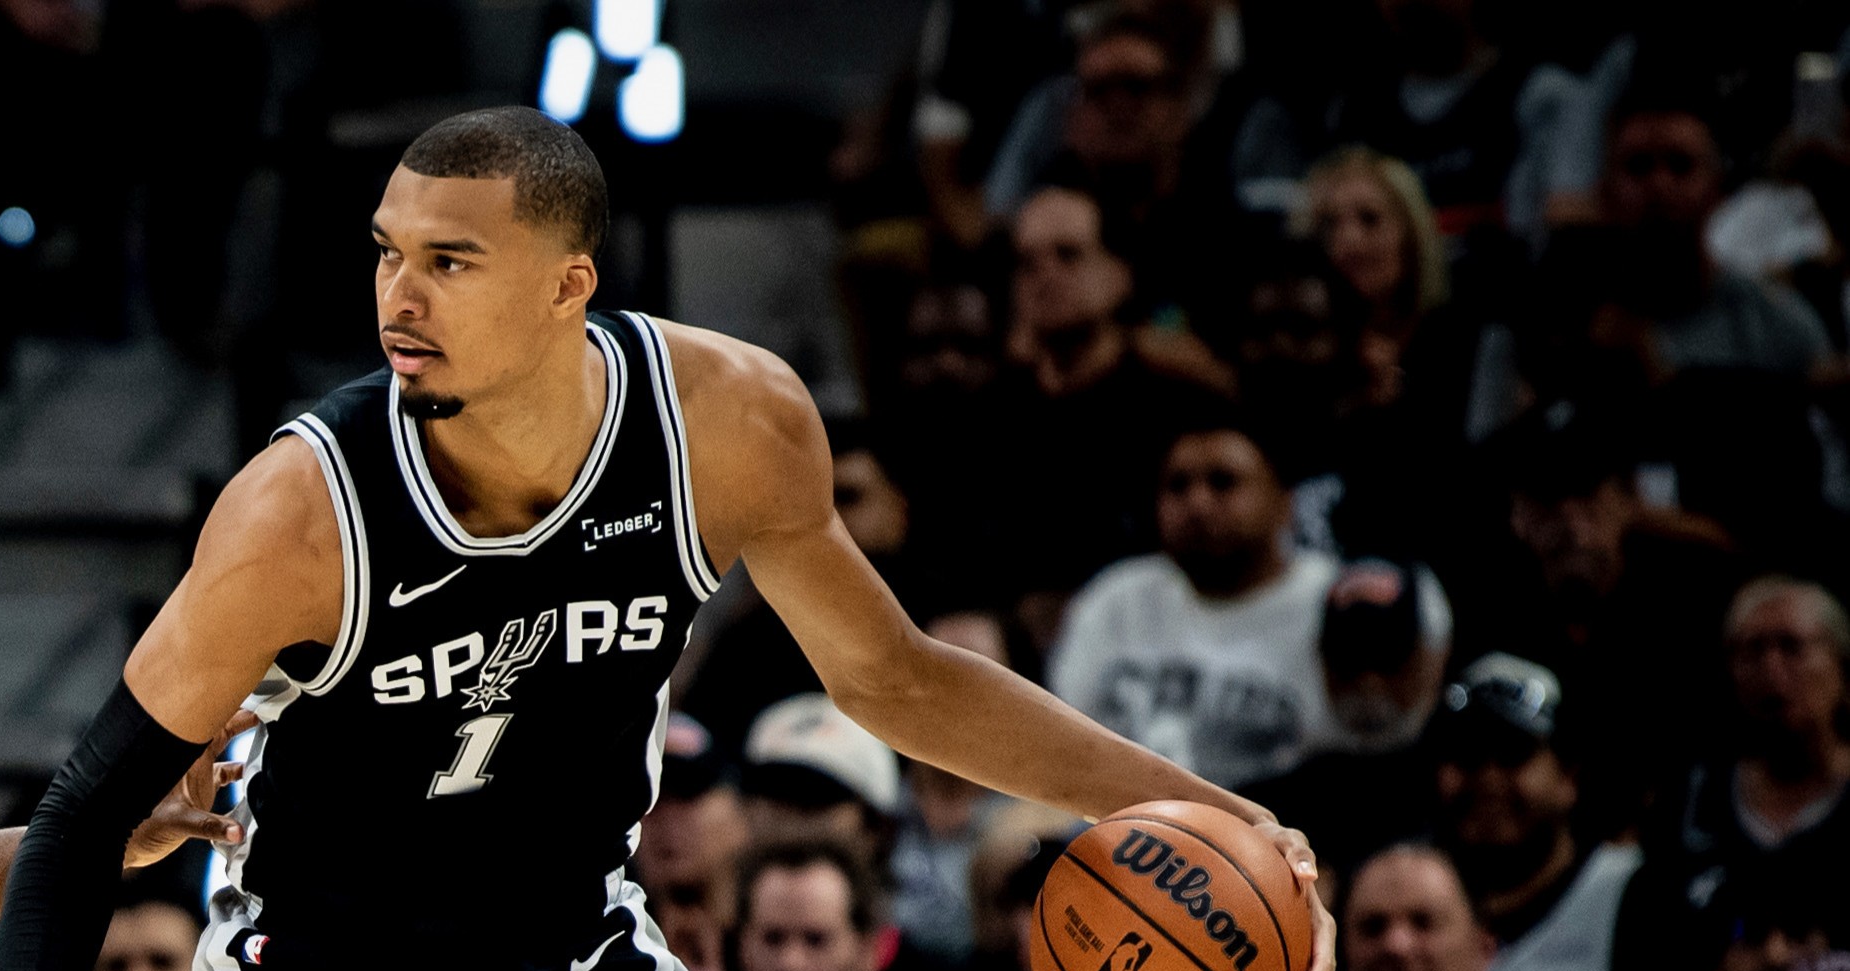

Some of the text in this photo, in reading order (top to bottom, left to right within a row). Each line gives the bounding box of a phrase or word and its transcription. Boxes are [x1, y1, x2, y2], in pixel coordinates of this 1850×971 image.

[593, 512, 653, 541] LEDGER
[370, 595, 668, 711] SPURS
[425, 712, 514, 800] 1
